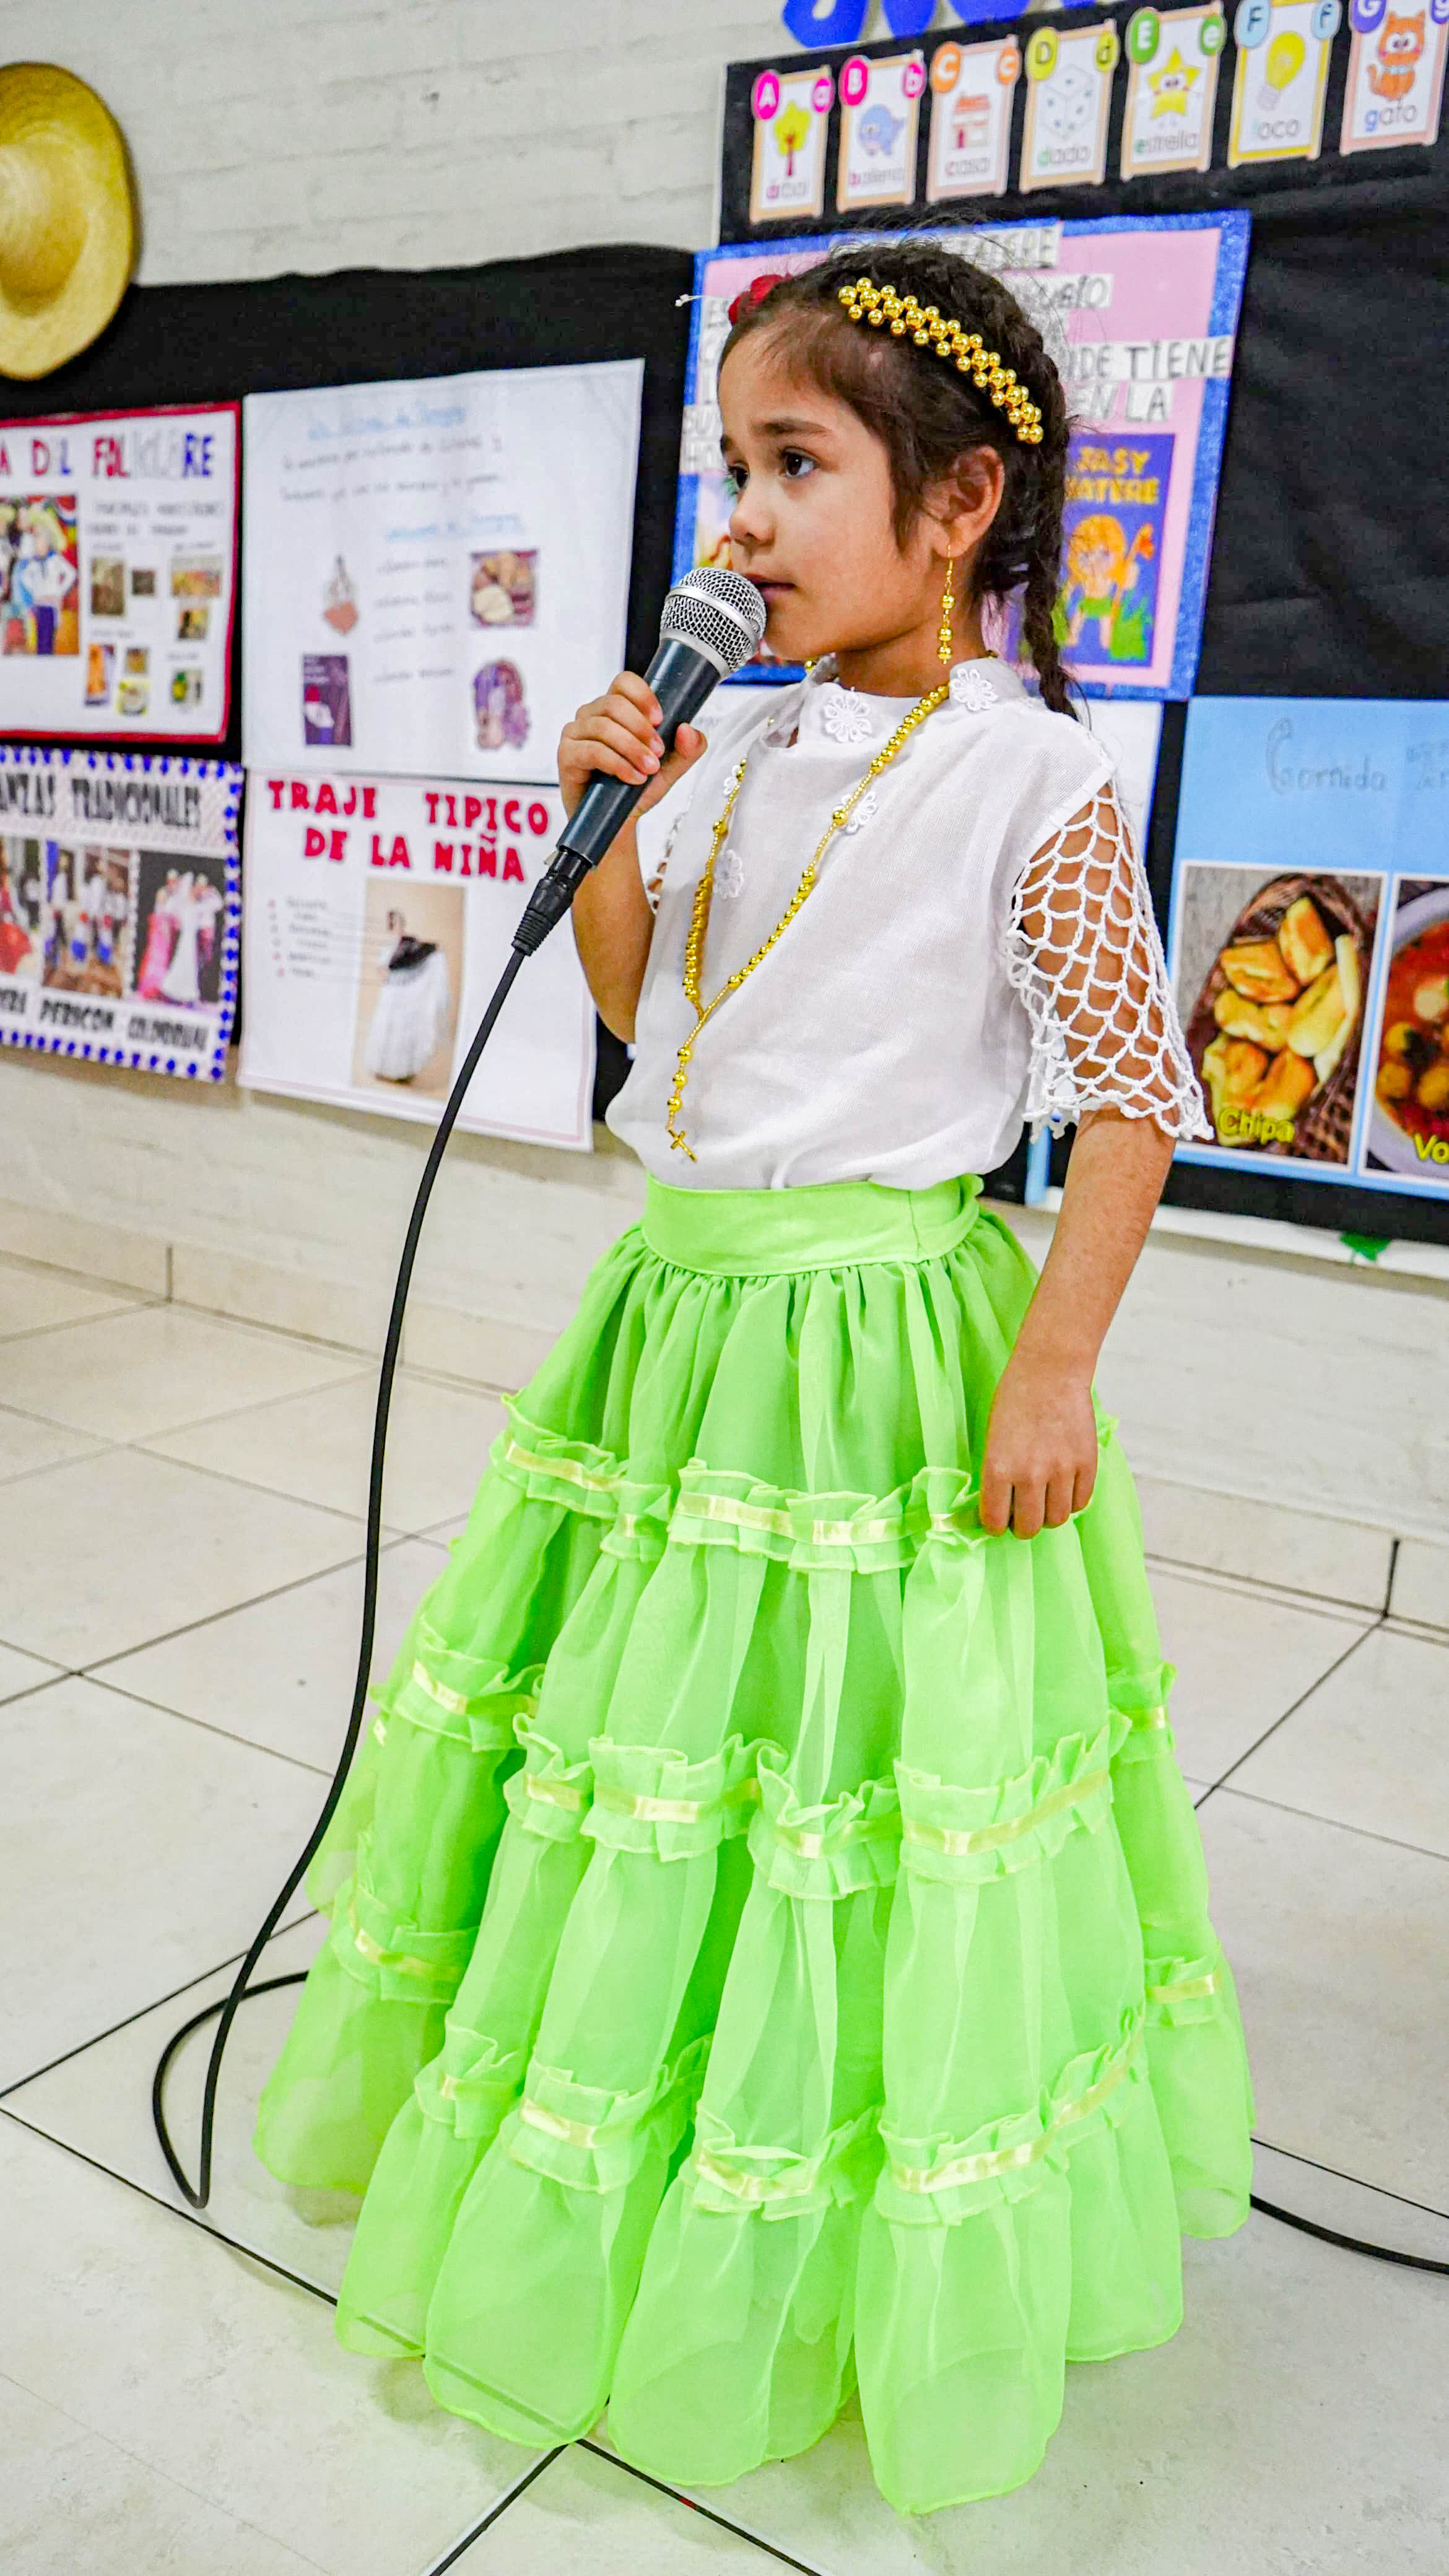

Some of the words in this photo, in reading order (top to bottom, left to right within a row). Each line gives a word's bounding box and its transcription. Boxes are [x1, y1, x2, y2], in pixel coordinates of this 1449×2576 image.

[1247, 6, 1262, 32] F
[1320, 3, 1333, 29] f
[1137, 20, 1152, 50] E
[1203, 25, 1221, 48] e
[937, 52, 957, 80] C
[1035, 41, 1052, 65] D
[1095, 42, 1112, 64] d
[758, 82, 778, 108] A
[847, 67, 863, 95] B
[1364, 100, 1417, 133] gato
[1125, 337, 1230, 381] TIENE
[1125, 386, 1167, 422] LA
[268, 780, 376, 819] TRAJE
[424, 792, 549, 835] TIPICO
[303, 827, 349, 861] DE
[371, 834, 411, 869] LA
[433, 832, 524, 882] NIÑA
[1218, 1107, 1295, 1145] Chipa
